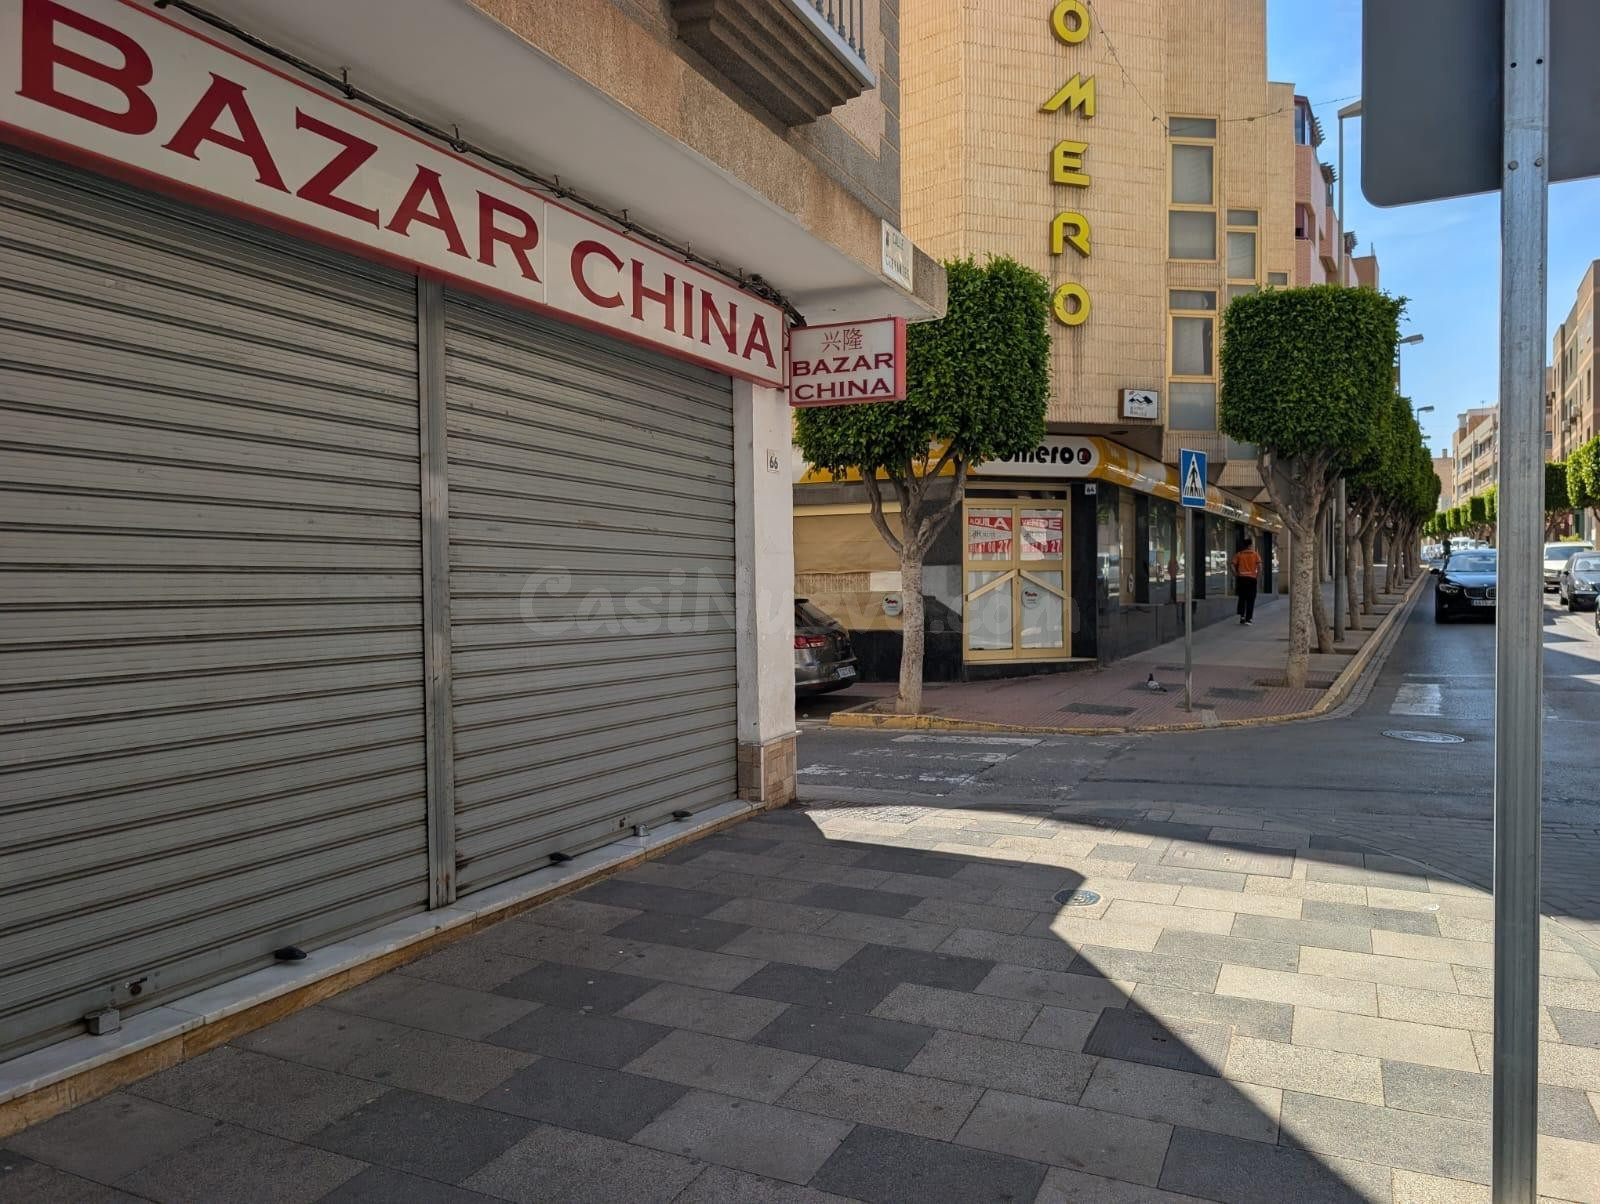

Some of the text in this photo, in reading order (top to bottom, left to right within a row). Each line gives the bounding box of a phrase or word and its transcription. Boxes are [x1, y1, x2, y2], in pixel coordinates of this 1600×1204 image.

[15, 0, 777, 369] BAZAR CHINA
[821, 328, 862, 352] 兴隆
[792, 353, 893, 376] BAZAR
[795, 378, 891, 400] CHINA
[769, 455, 779, 470] 66
[1021, 518, 1062, 530] VENDE
